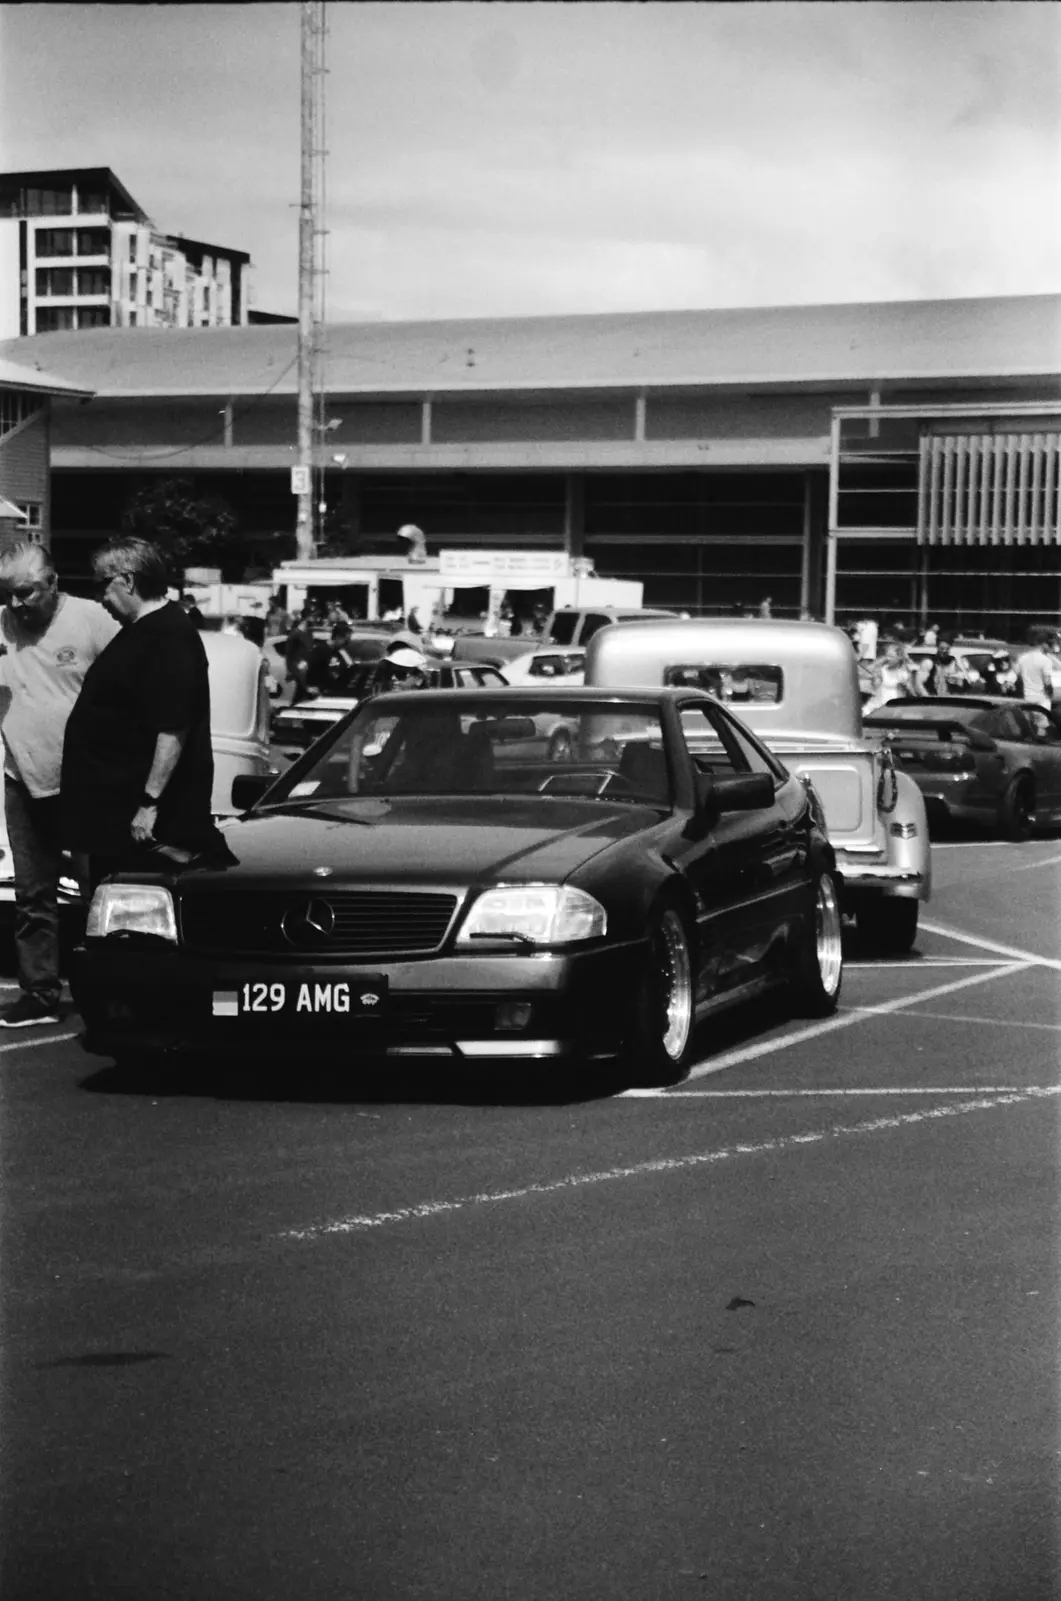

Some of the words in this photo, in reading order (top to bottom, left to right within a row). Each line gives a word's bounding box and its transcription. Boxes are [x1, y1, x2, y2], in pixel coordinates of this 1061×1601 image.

[294, 470, 306, 490] 3
[242, 982, 286, 1012] 129
[296, 982, 351, 1013] AMG
